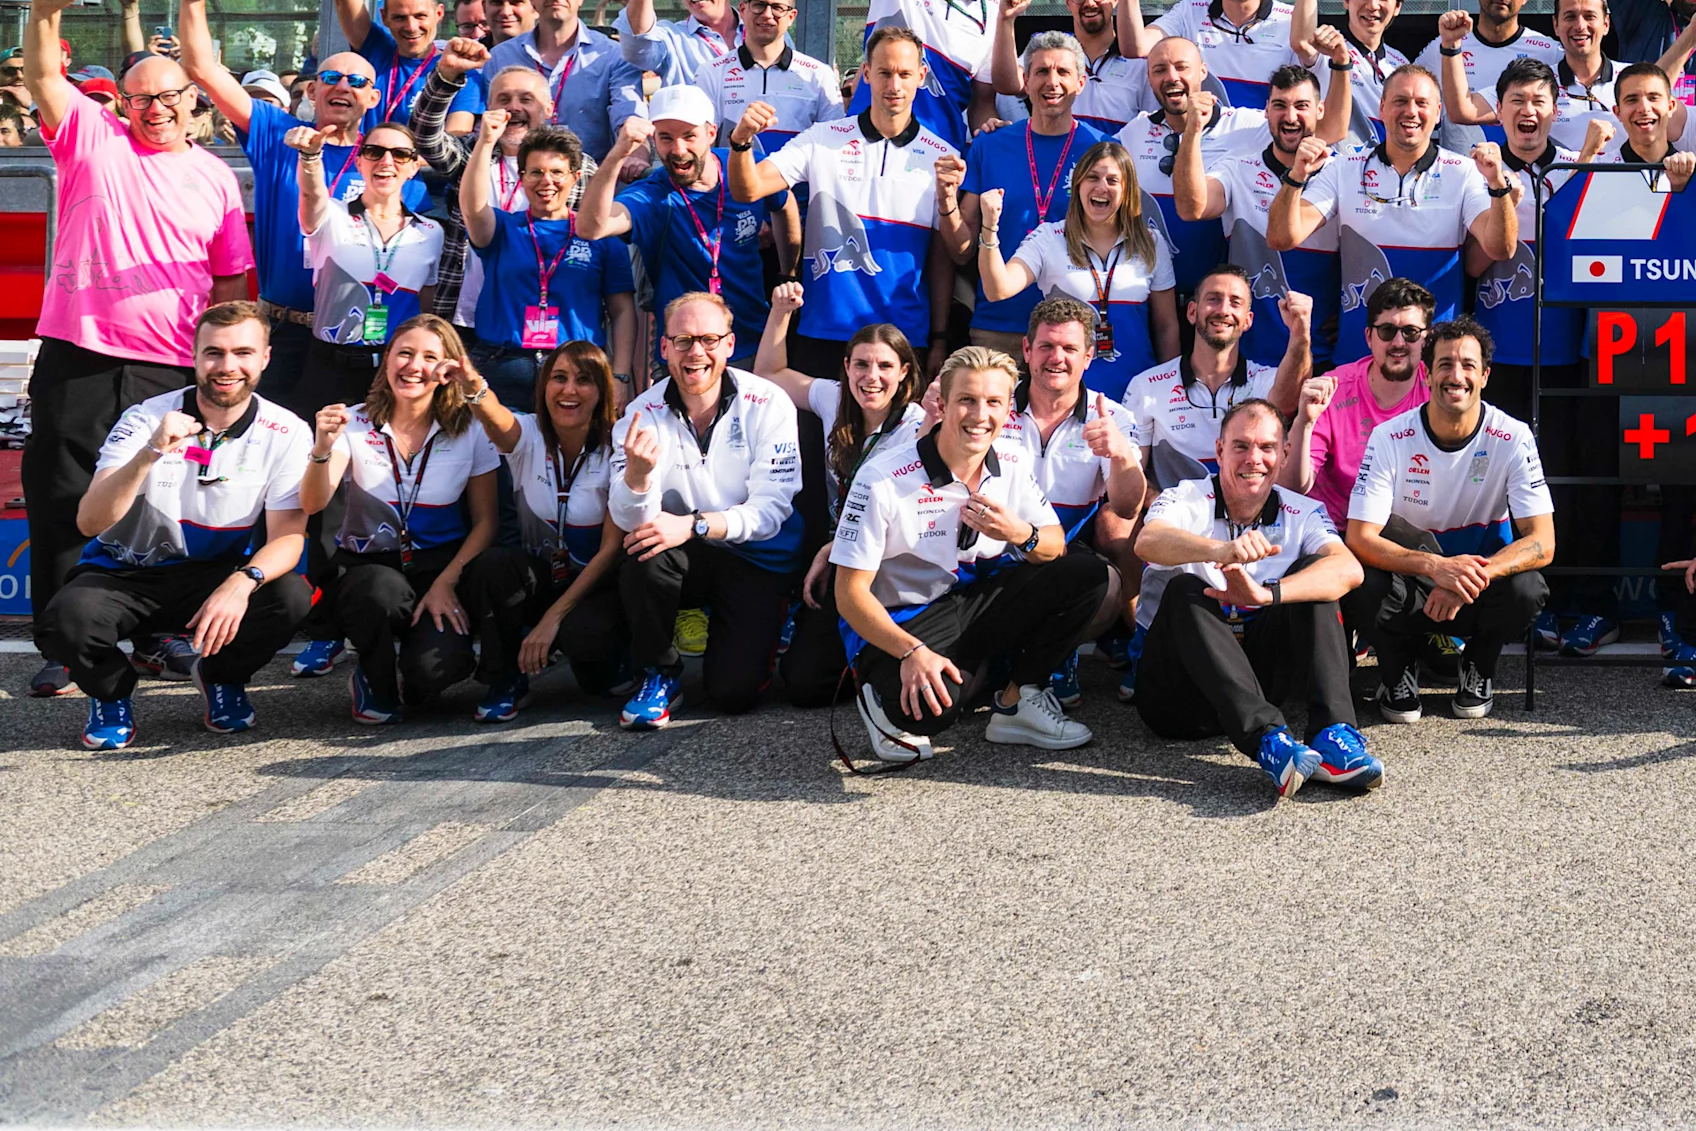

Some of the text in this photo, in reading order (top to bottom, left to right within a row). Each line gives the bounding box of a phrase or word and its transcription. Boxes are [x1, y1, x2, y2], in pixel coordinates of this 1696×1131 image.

[1525, 39, 1551, 49] HUGO
[713, 57, 737, 68] HUGO
[793, 58, 818, 70] HUGO
[830, 125, 855, 133] HUGO
[920, 136, 947, 153] HUGO
[1436, 156, 1462, 166] HUGO
[736, 209, 752, 220] VISA
[572, 239, 589, 248] VISA
[526, 320, 559, 332] VIP
[1148, 370, 1177, 383] HUGO
[1335, 396, 1359, 411] HUGO
[257, 416, 289, 434] HUGO
[1170, 423, 1196, 431] TUDOR
[1390, 428, 1416, 441] HUGO
[1484, 426, 1512, 441] HUGO
[891, 460, 923, 479] HUGO
[1408, 467, 1430, 475] ORLEN
[917, 496, 943, 504] ORLEN
[1402, 496, 1429, 506] TUDOR
[917, 508, 946, 516] HONDA
[918, 530, 947, 539] TUDOR
